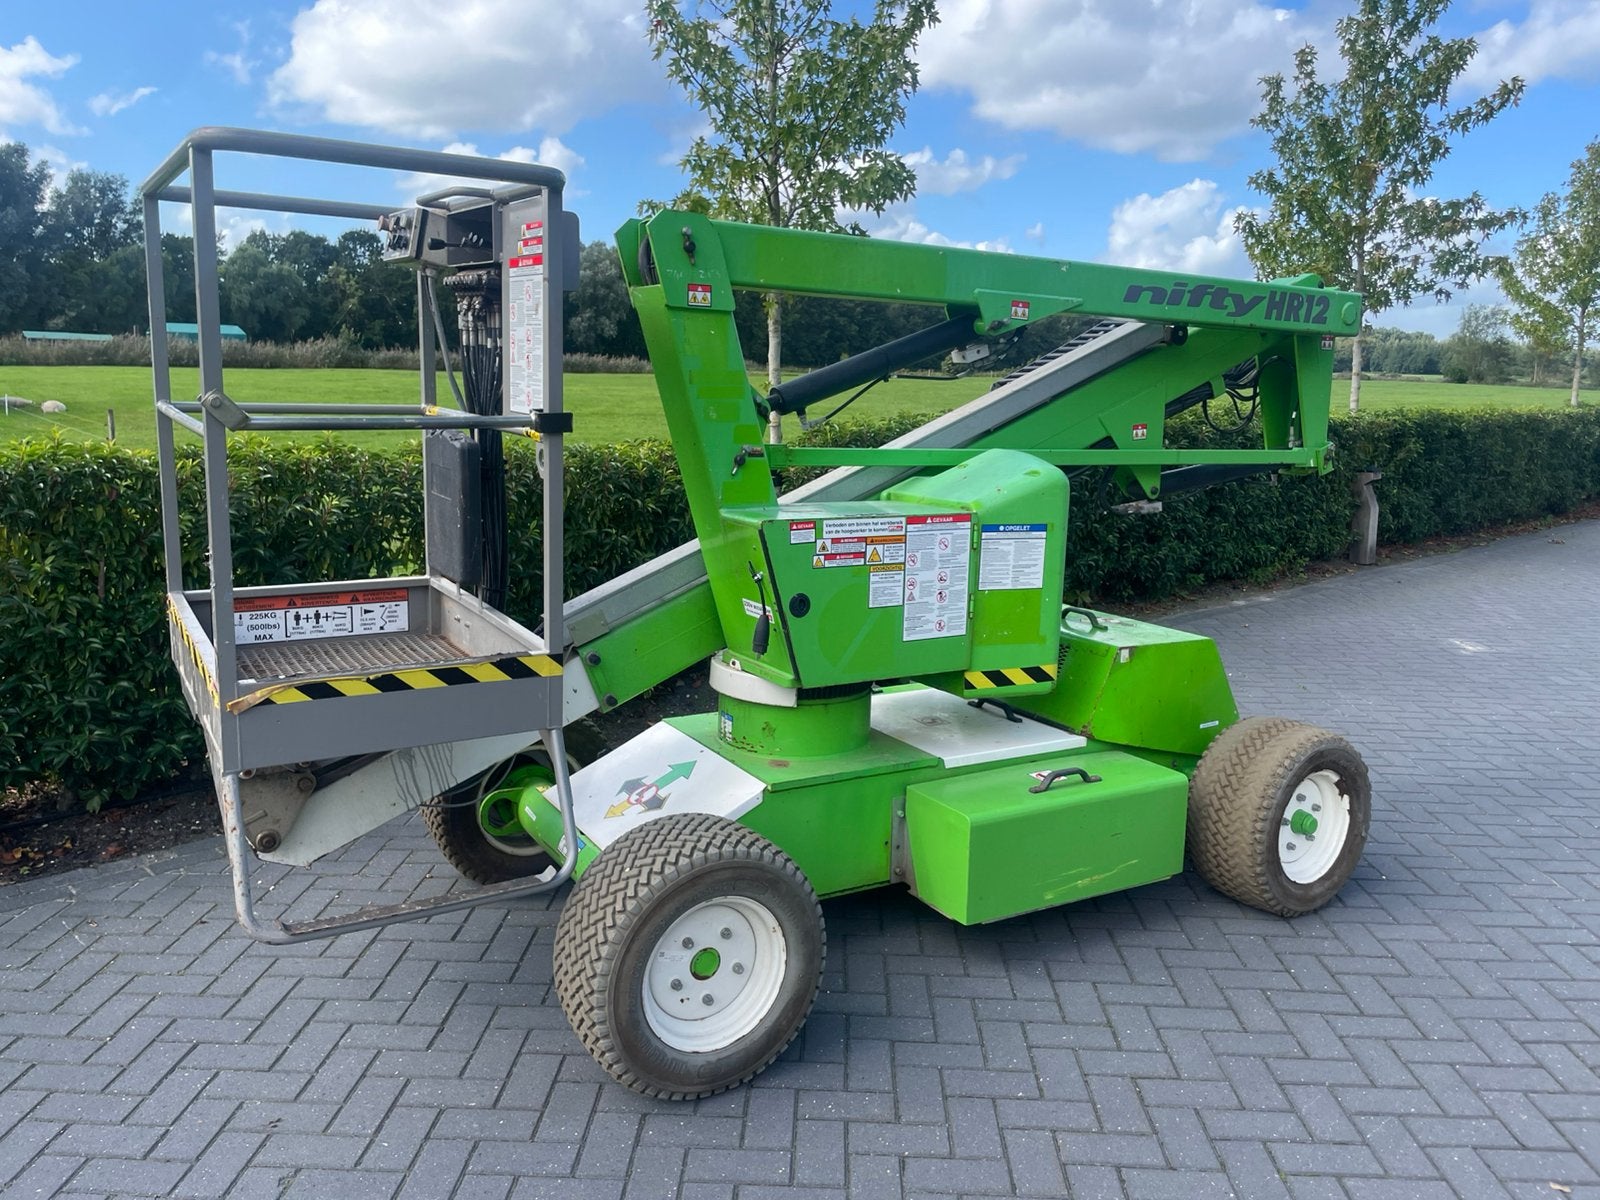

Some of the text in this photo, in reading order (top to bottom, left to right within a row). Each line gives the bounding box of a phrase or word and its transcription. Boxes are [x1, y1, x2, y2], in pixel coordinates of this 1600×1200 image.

[1123, 281, 1330, 325] nifty HR12
[249, 612, 277, 621] 225KG
[246, 622, 280, 633] (500lbs)
